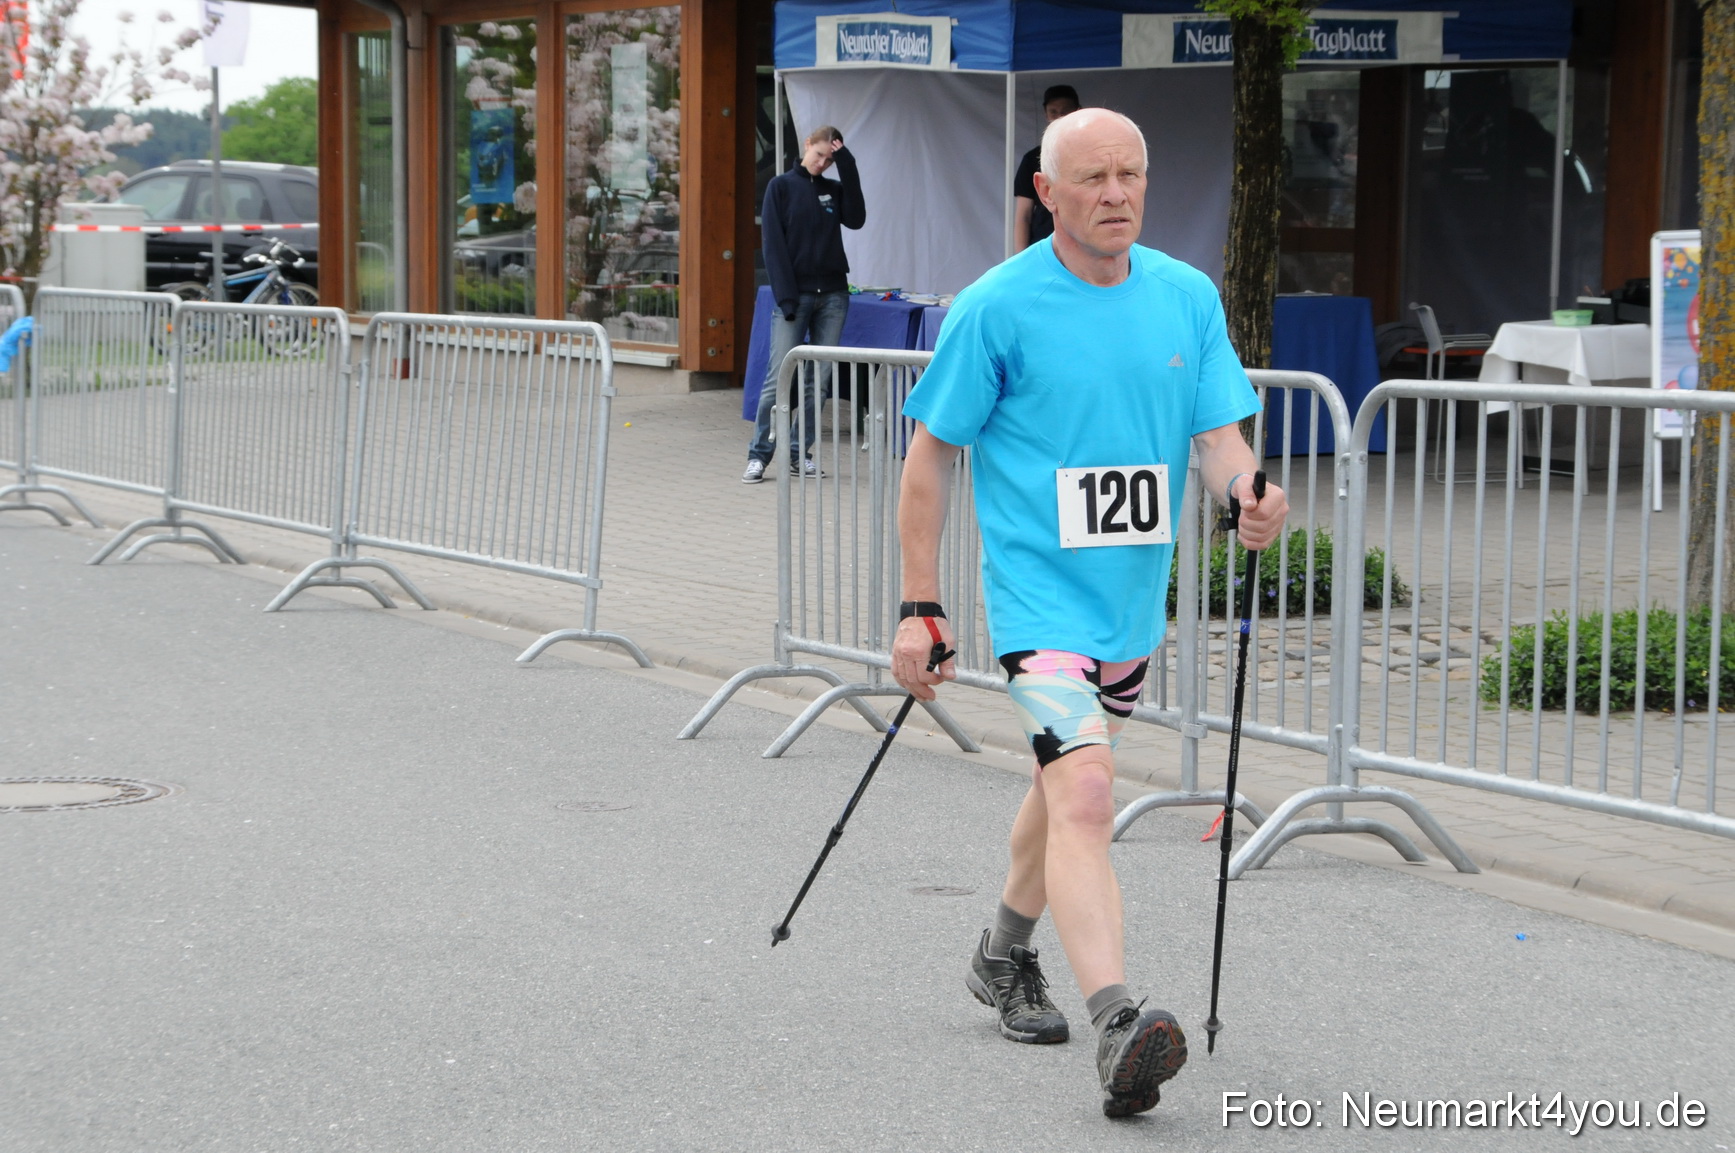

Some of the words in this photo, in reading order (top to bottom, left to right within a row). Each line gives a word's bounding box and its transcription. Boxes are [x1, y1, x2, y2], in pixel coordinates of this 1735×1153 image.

[890, 29, 928, 57] Tagblatt
[1305, 26, 1387, 55] Tagblatt
[1078, 469, 1159, 534] 120
